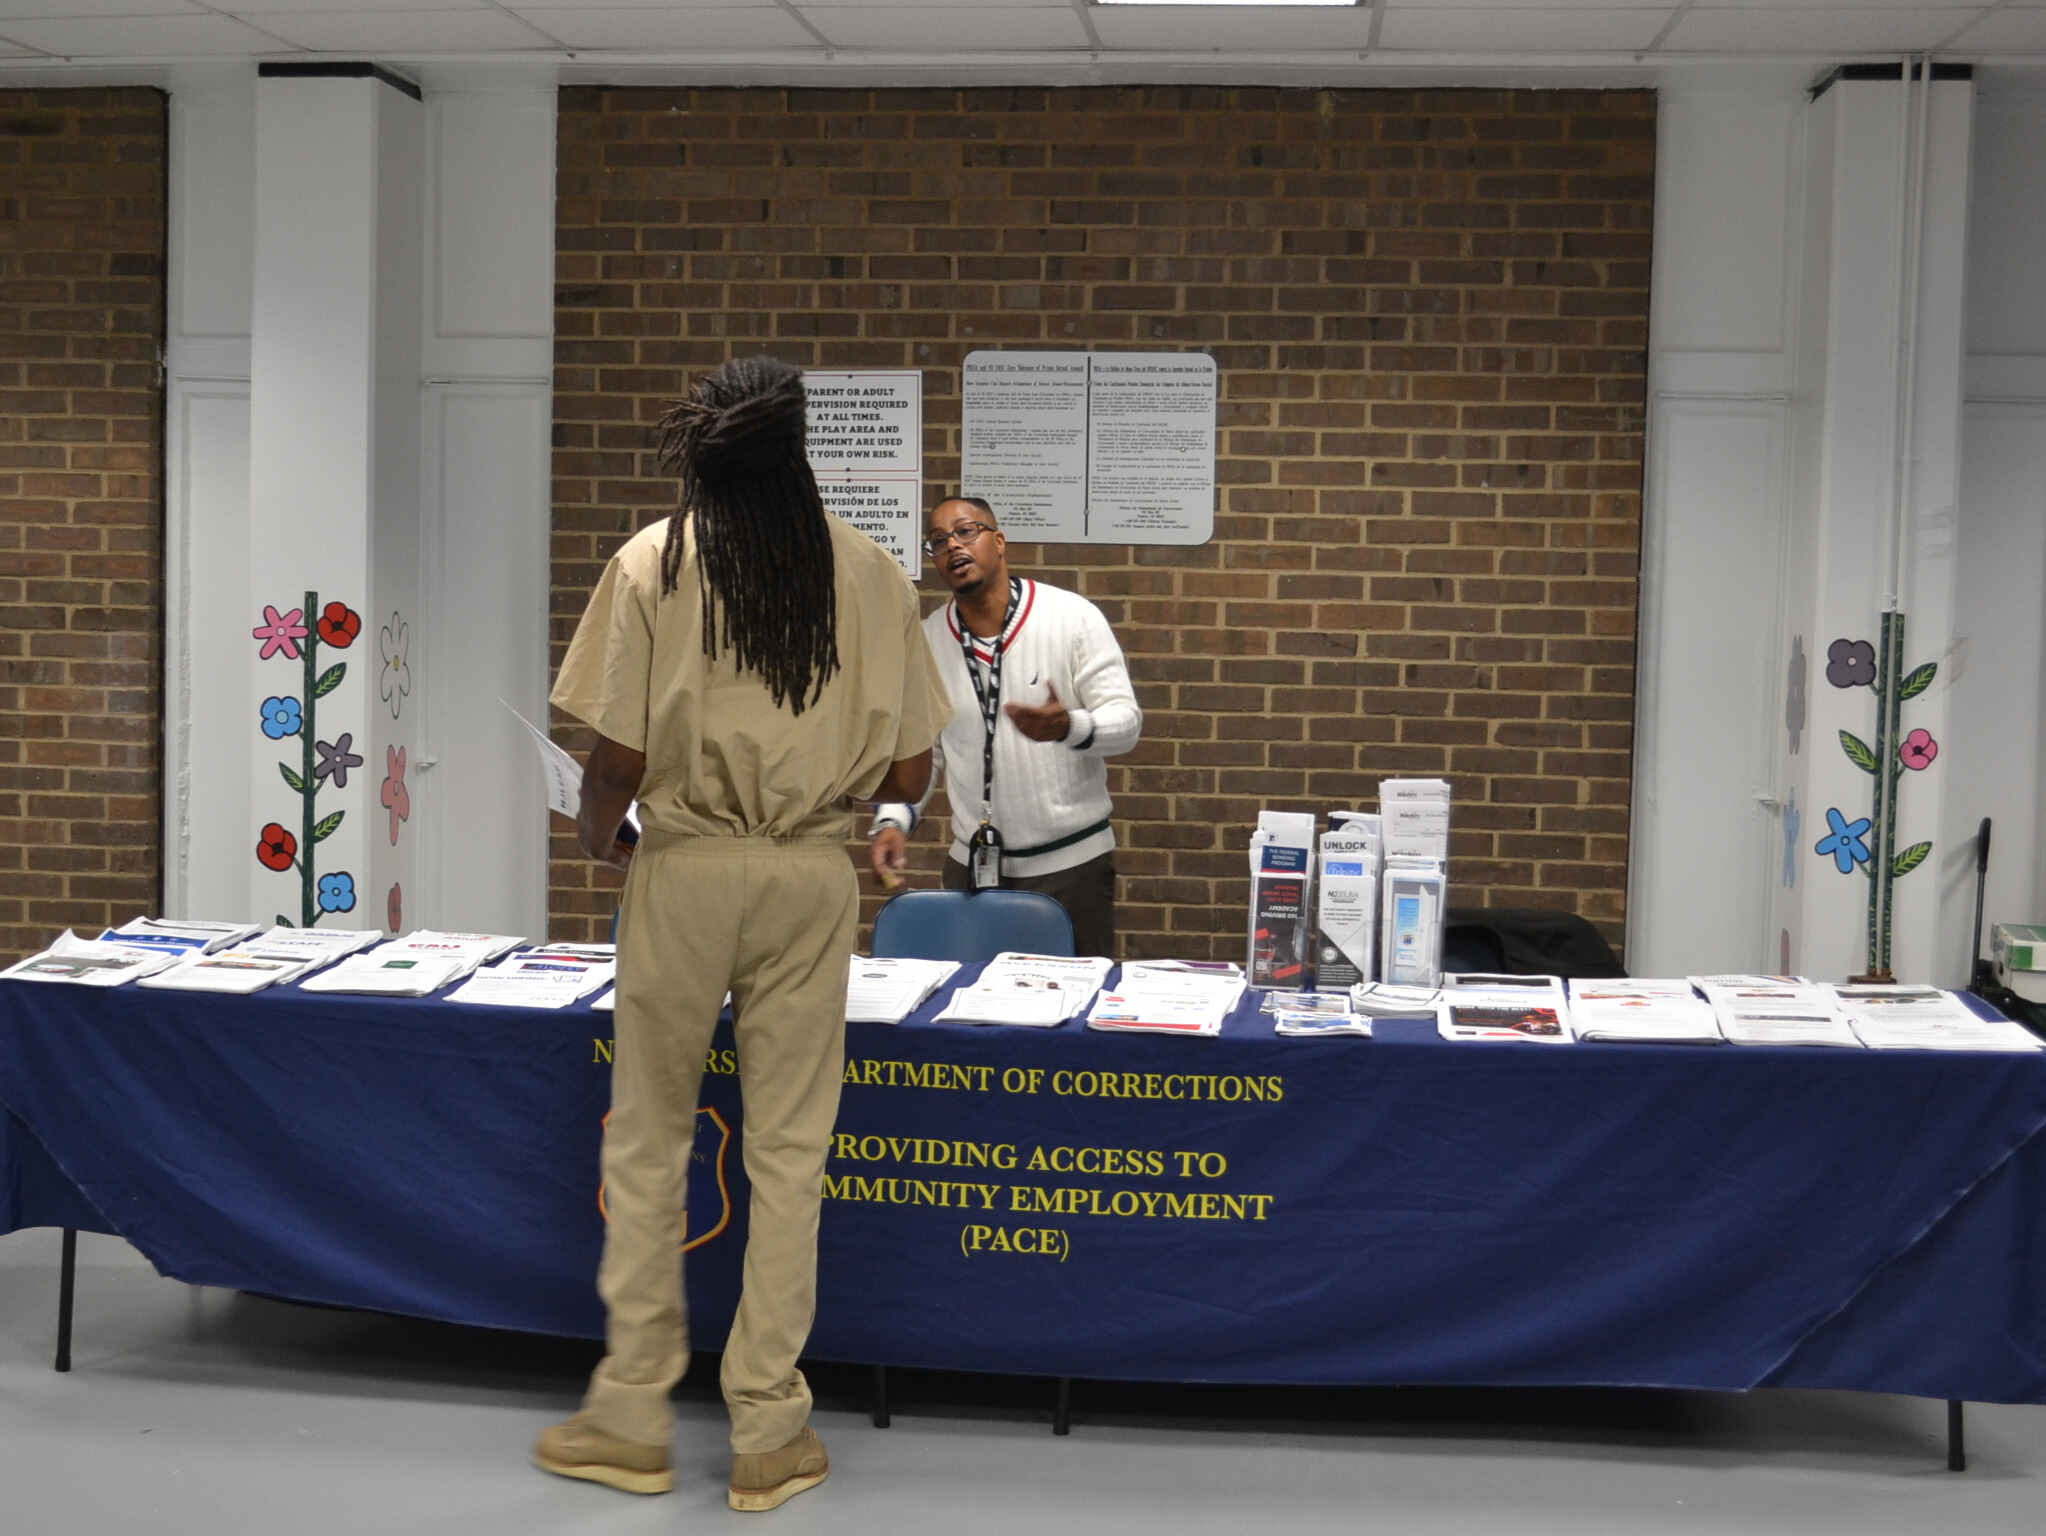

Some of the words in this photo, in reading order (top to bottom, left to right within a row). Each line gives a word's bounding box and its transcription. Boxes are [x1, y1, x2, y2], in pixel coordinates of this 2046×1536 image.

[859, 401, 908, 410] REQUIRED
[805, 438, 854, 447] QUIPMENT
[832, 486, 880, 495] REQUIERE
[824, 496, 865, 506] RVISIÓN
[850, 523, 889, 531] MENTO.
[1324, 841, 1367, 850] UNLOCK
[843, 1059, 994, 1092] ARTMENT
[1002, 1068, 1045, 1094] OF
[1053, 1070, 1283, 1102] CORRECTIONS
[1027, 1145, 1164, 1176] ACCESS
[1174, 1151, 1227, 1178] TO
[822, 1174, 1001, 1210] MMUNITY
[1009, 1186, 1273, 1220] EMPLOYMENT
[961, 1224, 1070, 1262] (PACE)
